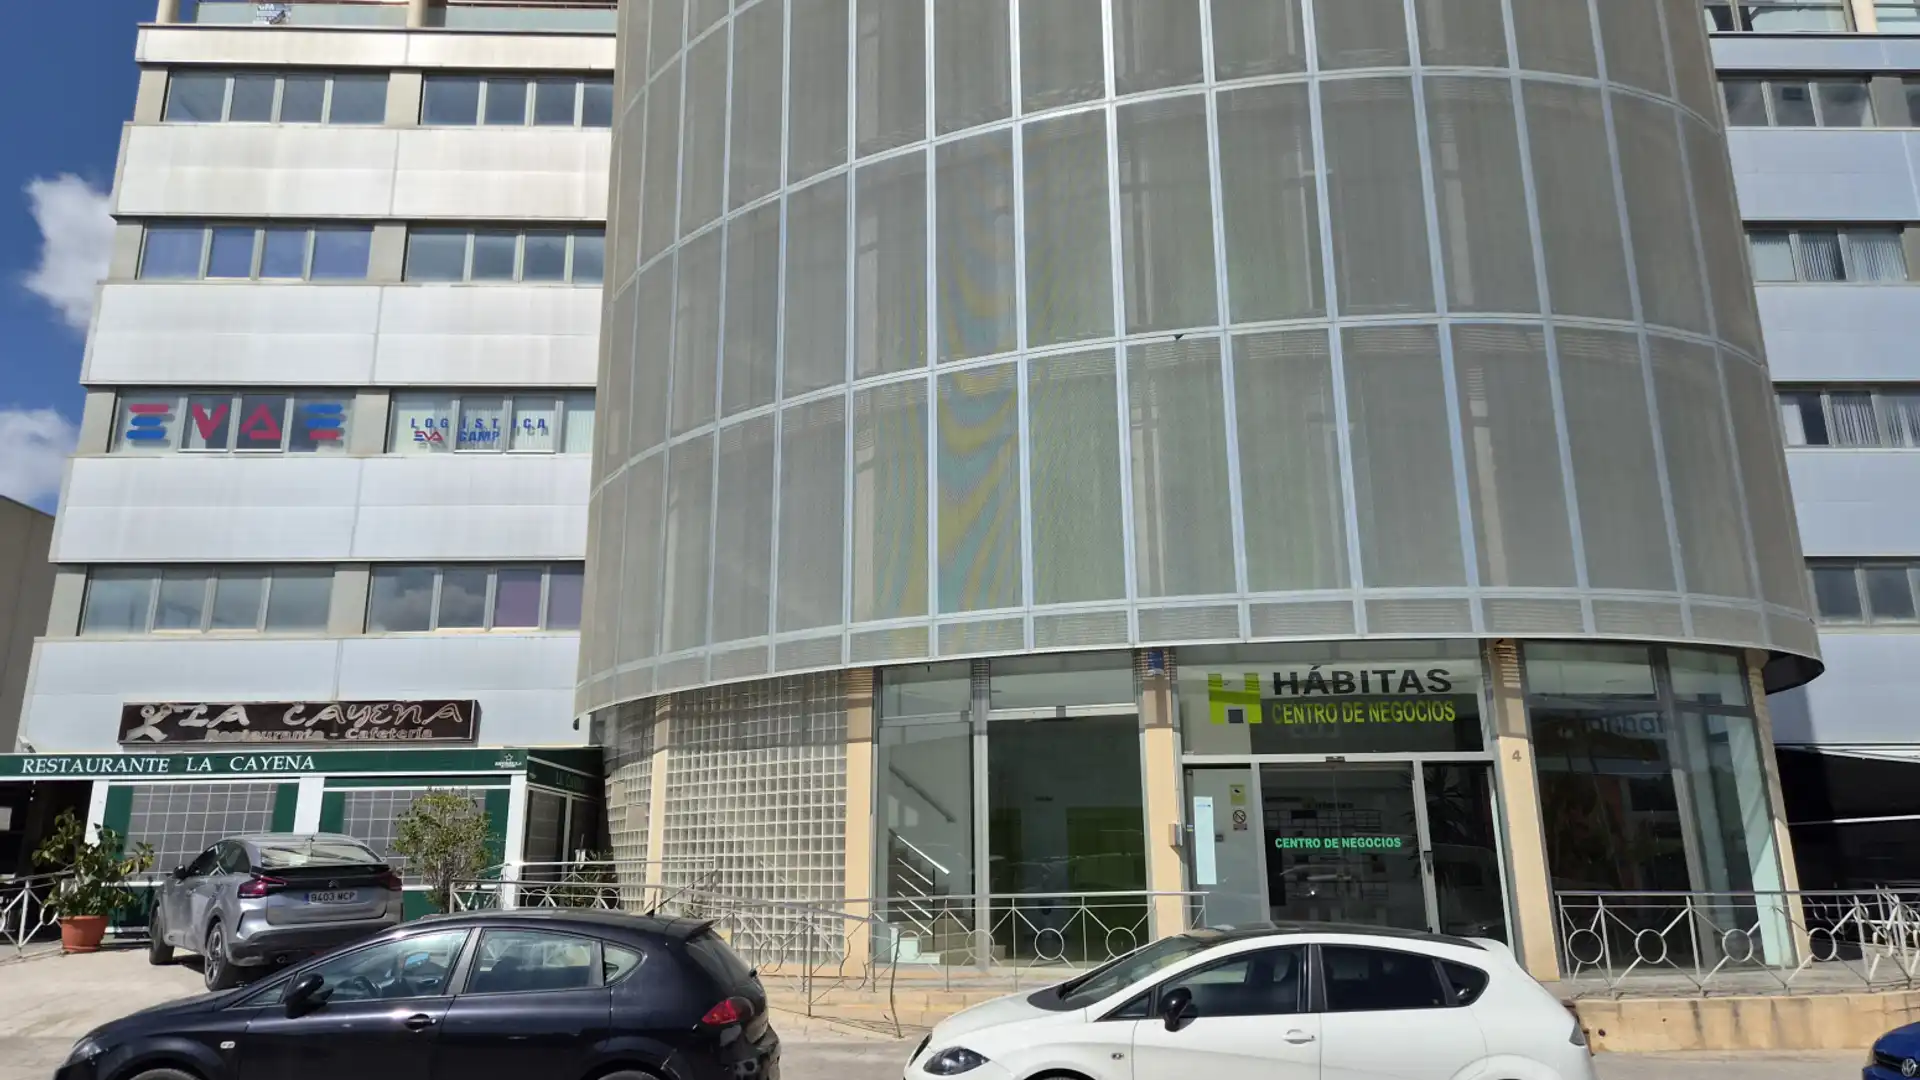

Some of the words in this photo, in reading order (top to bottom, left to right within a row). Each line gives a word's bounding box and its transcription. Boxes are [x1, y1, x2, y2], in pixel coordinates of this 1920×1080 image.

[460, 431, 500, 442] CAMP
[1273, 665, 1452, 695] HÁBITAS
[173, 703, 250, 728] LA
[283, 702, 463, 727] CAYENA
[1272, 703, 1338, 724] CENTRO
[1342, 702, 1365, 723] DE
[1369, 699, 1456, 723] NEGOCIOS
[21, 757, 170, 773] RESTAURANTE
[186, 757, 212, 771] LA
[230, 755, 315, 772] CAYENA
[1512, 750, 1522, 762] 4
[1275, 837, 1321, 849] CENTRO
[1324, 838, 1339, 849] DE
[1342, 836, 1402, 848] NEGOCIOS
